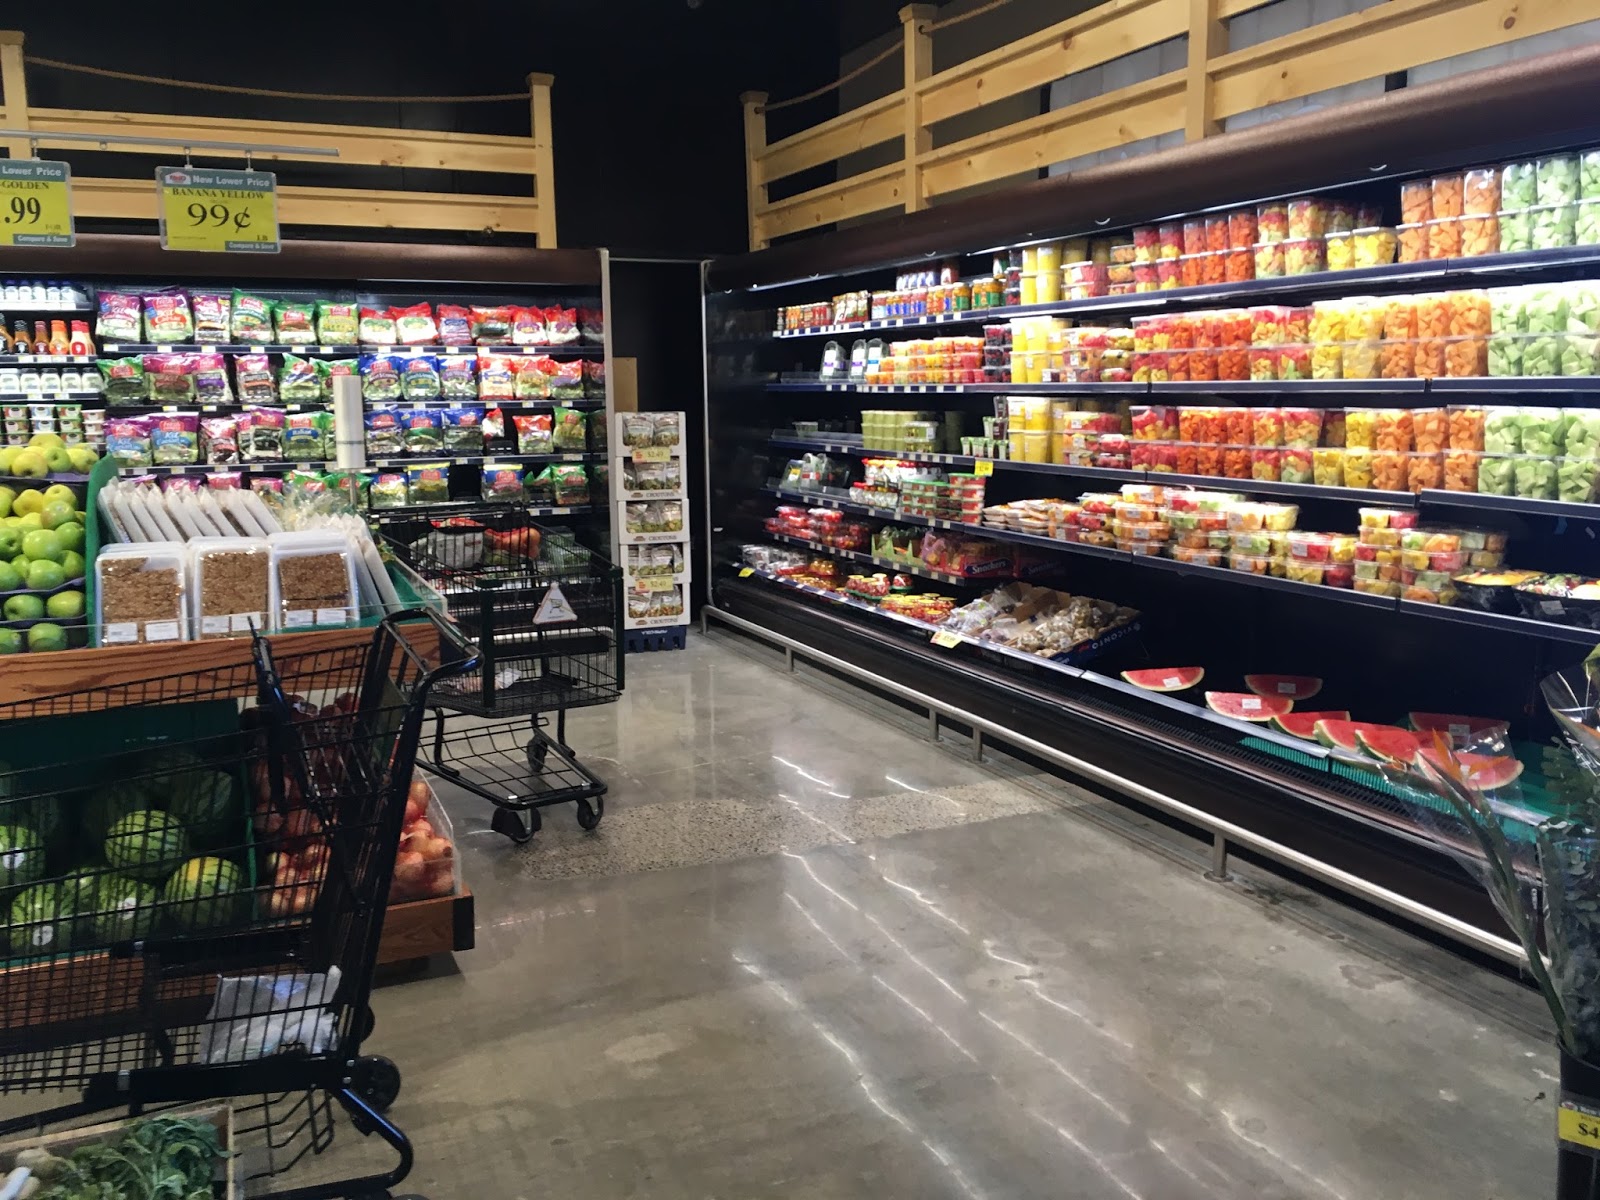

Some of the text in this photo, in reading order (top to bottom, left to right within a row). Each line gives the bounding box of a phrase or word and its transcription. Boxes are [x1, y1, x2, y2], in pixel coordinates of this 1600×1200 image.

[2, 165, 62, 177] Lower Price
[192, 175, 214, 185] New
[216, 176, 244, 186] Lower
[246, 177, 270, 187] Price
[171, 187, 265, 200] BANANA YELLOW
[187, 202, 251, 234] 99¢
[17, 235, 45, 243] Compare
[228, 242, 254, 250] Compare
[649, 617, 679, 625] CROUTONS
